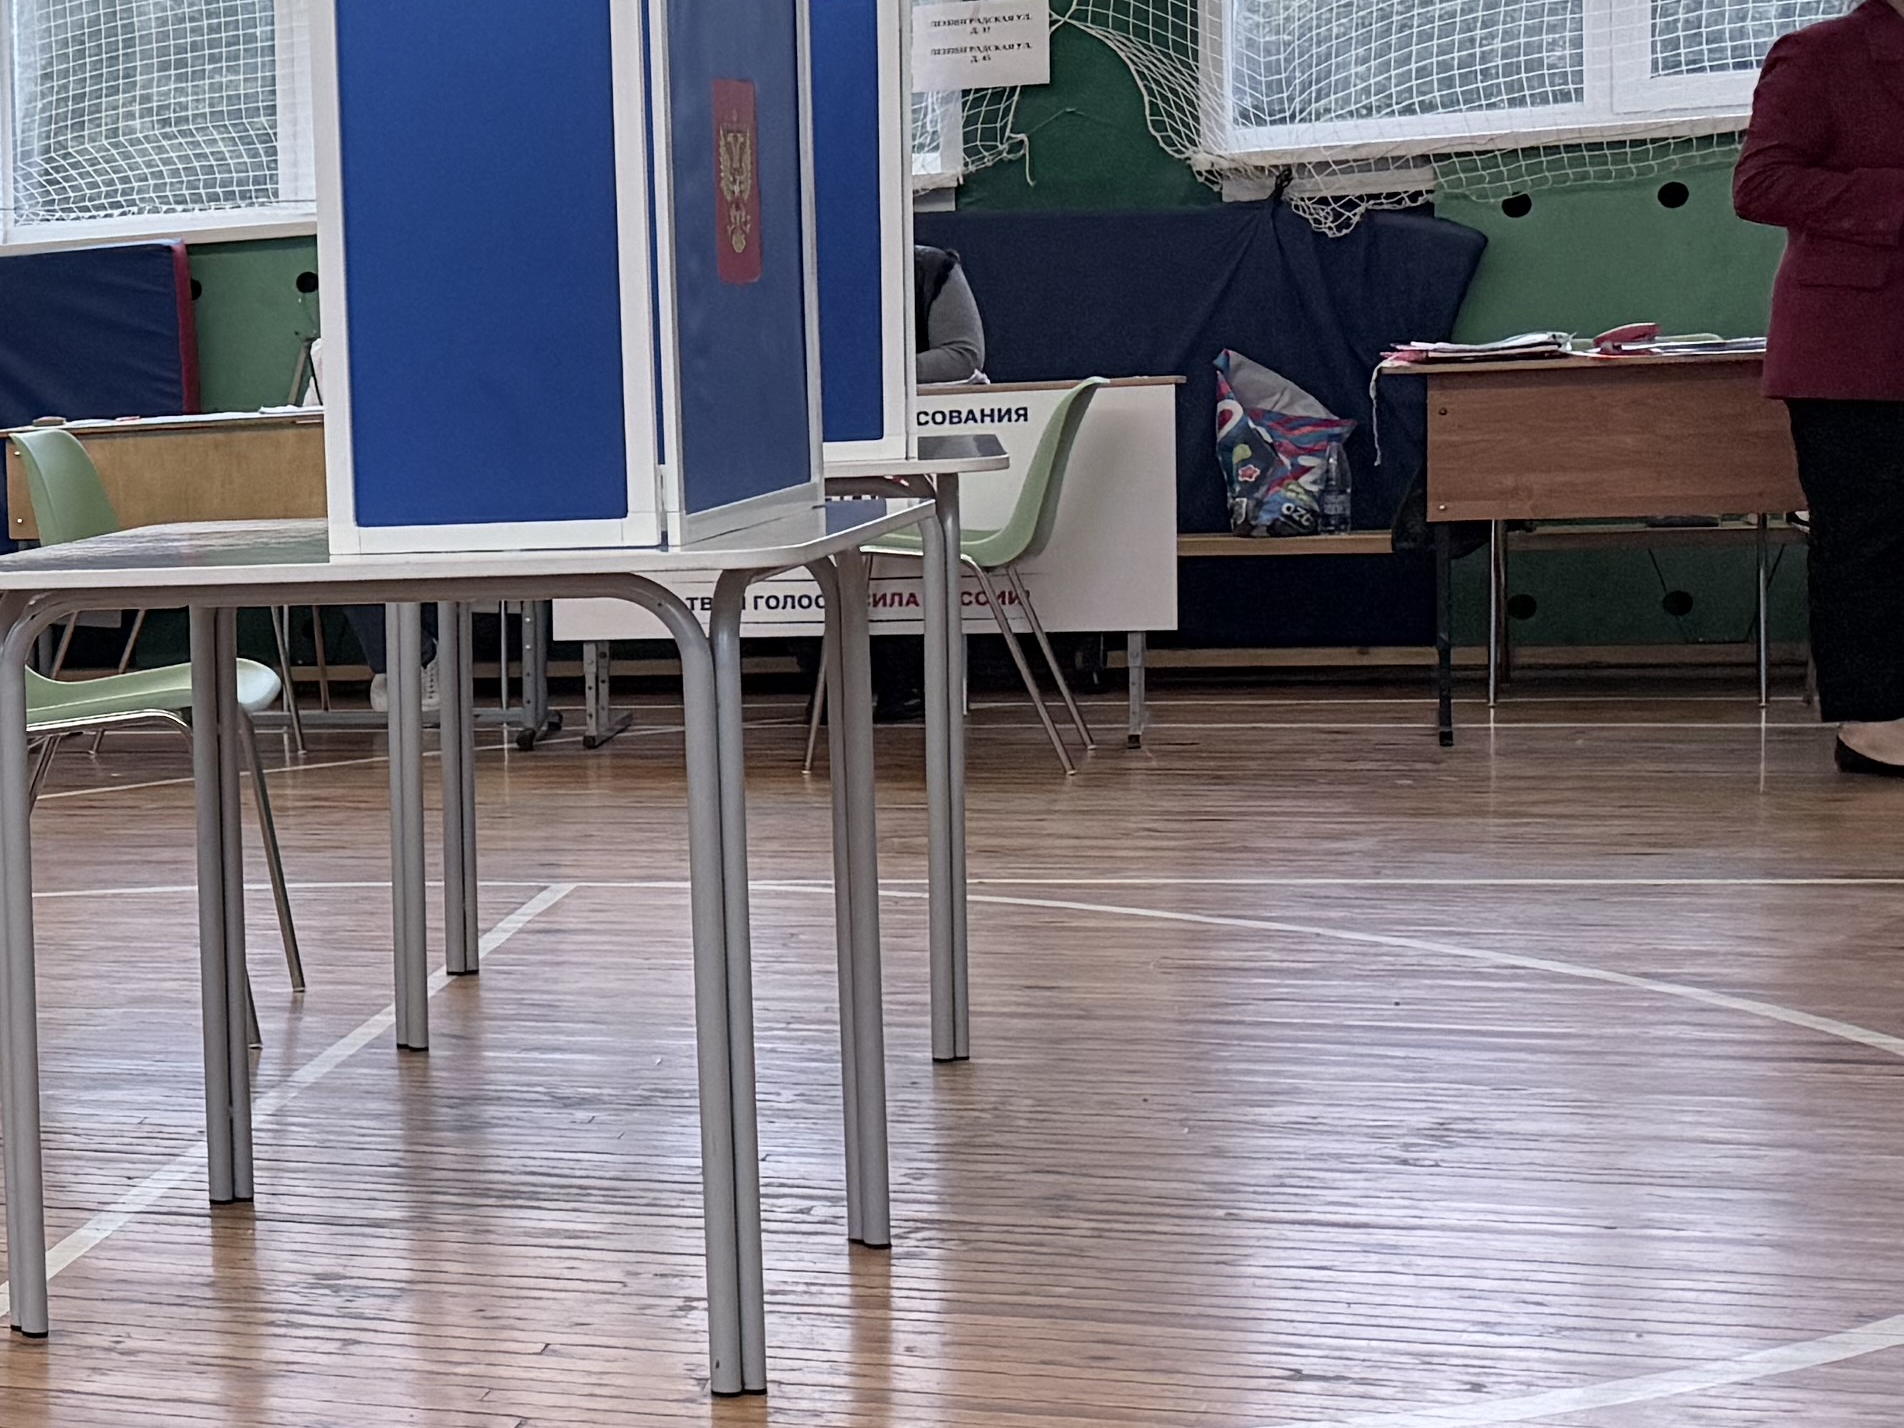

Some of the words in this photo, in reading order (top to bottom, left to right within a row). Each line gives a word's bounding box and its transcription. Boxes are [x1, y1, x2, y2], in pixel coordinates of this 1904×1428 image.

[916, 406, 1029, 426] СОВАНИЯ
[753, 594, 825, 611] ГОЛОС
[867, 592, 920, 609] ИЛА
